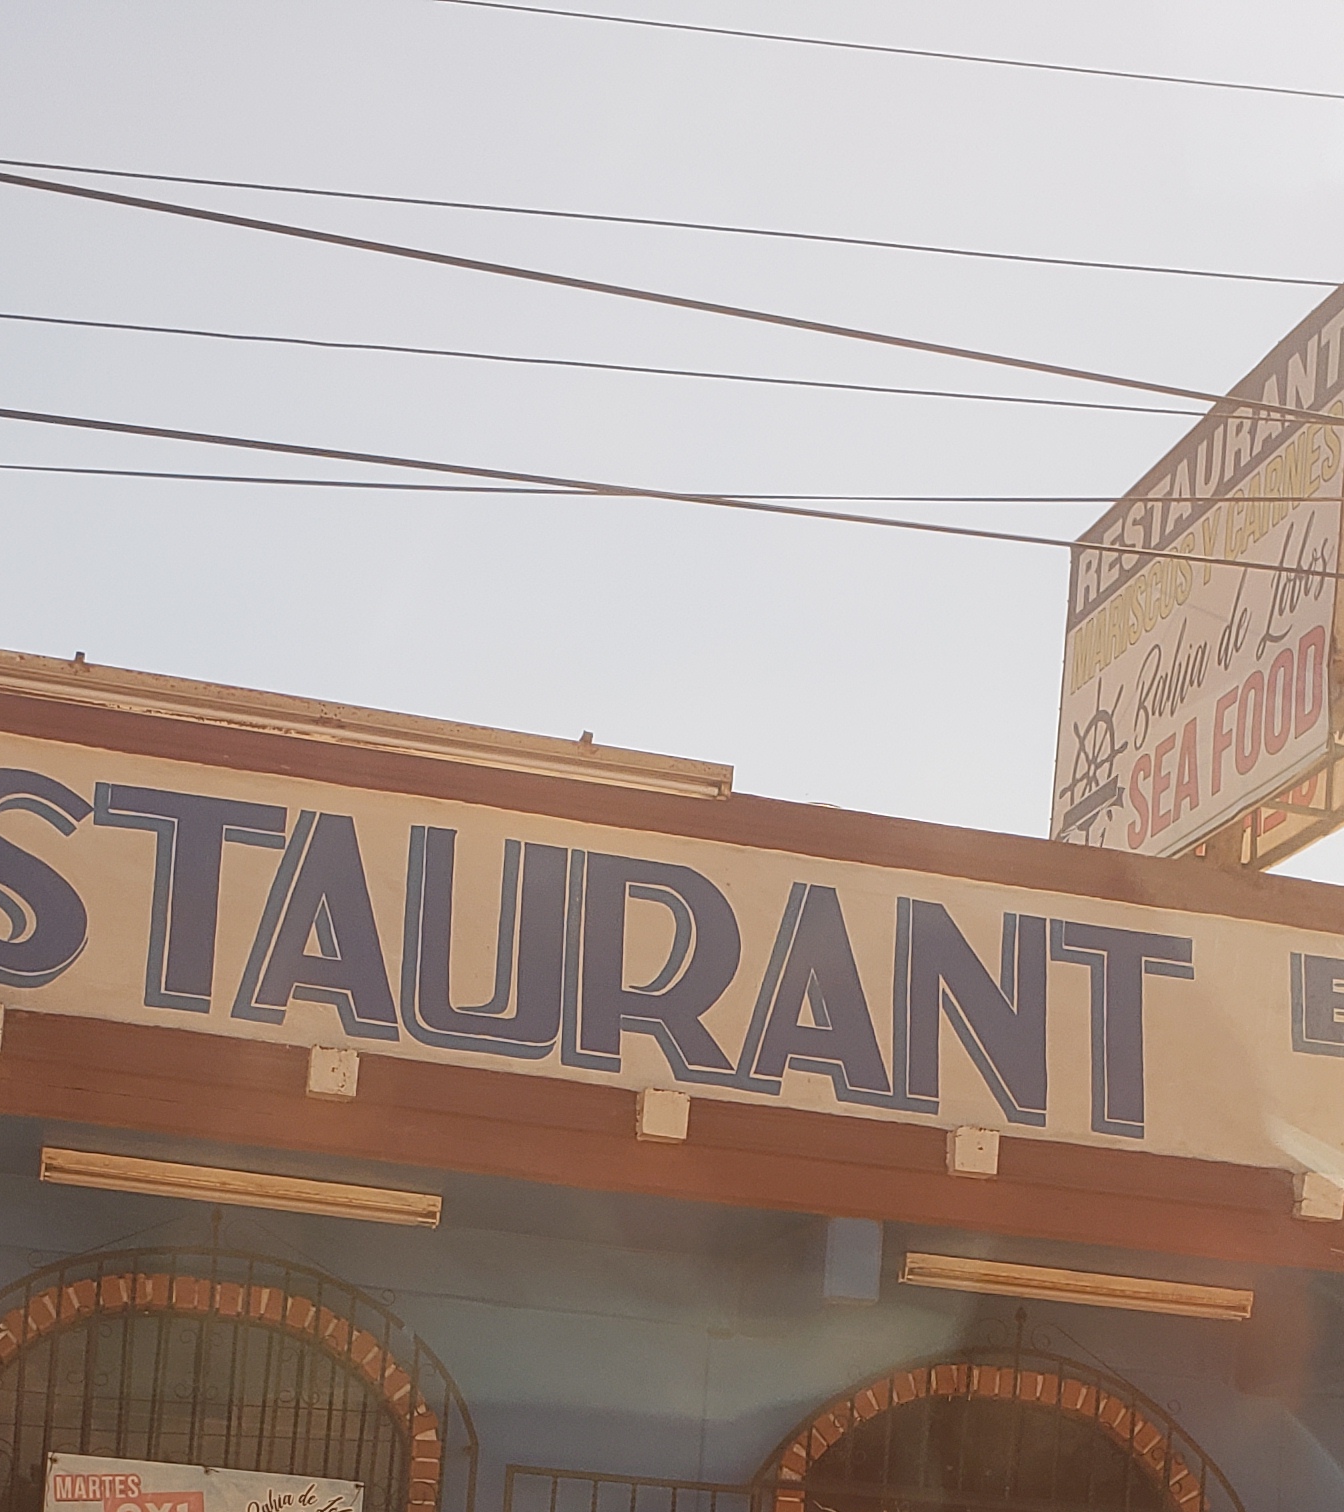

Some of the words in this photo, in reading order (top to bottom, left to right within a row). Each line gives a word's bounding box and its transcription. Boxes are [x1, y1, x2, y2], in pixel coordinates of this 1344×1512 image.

[1070, 531, 1195, 695] MARISCOS
[1202, 503, 1223, 586] Y
[1224, 400, 1344, 560] CARNES
[1133, 618, 1209, 750] Bahia
[1217, 567, 1251, 671] de
[1256, 510, 1334, 661] Lobos
[1127, 716, 1199, 849] SEA
[1212, 625, 1326, 797] FOOD
[55, 1474, 141, 1500] MARTES
[298, 1484, 318, 1506] de
